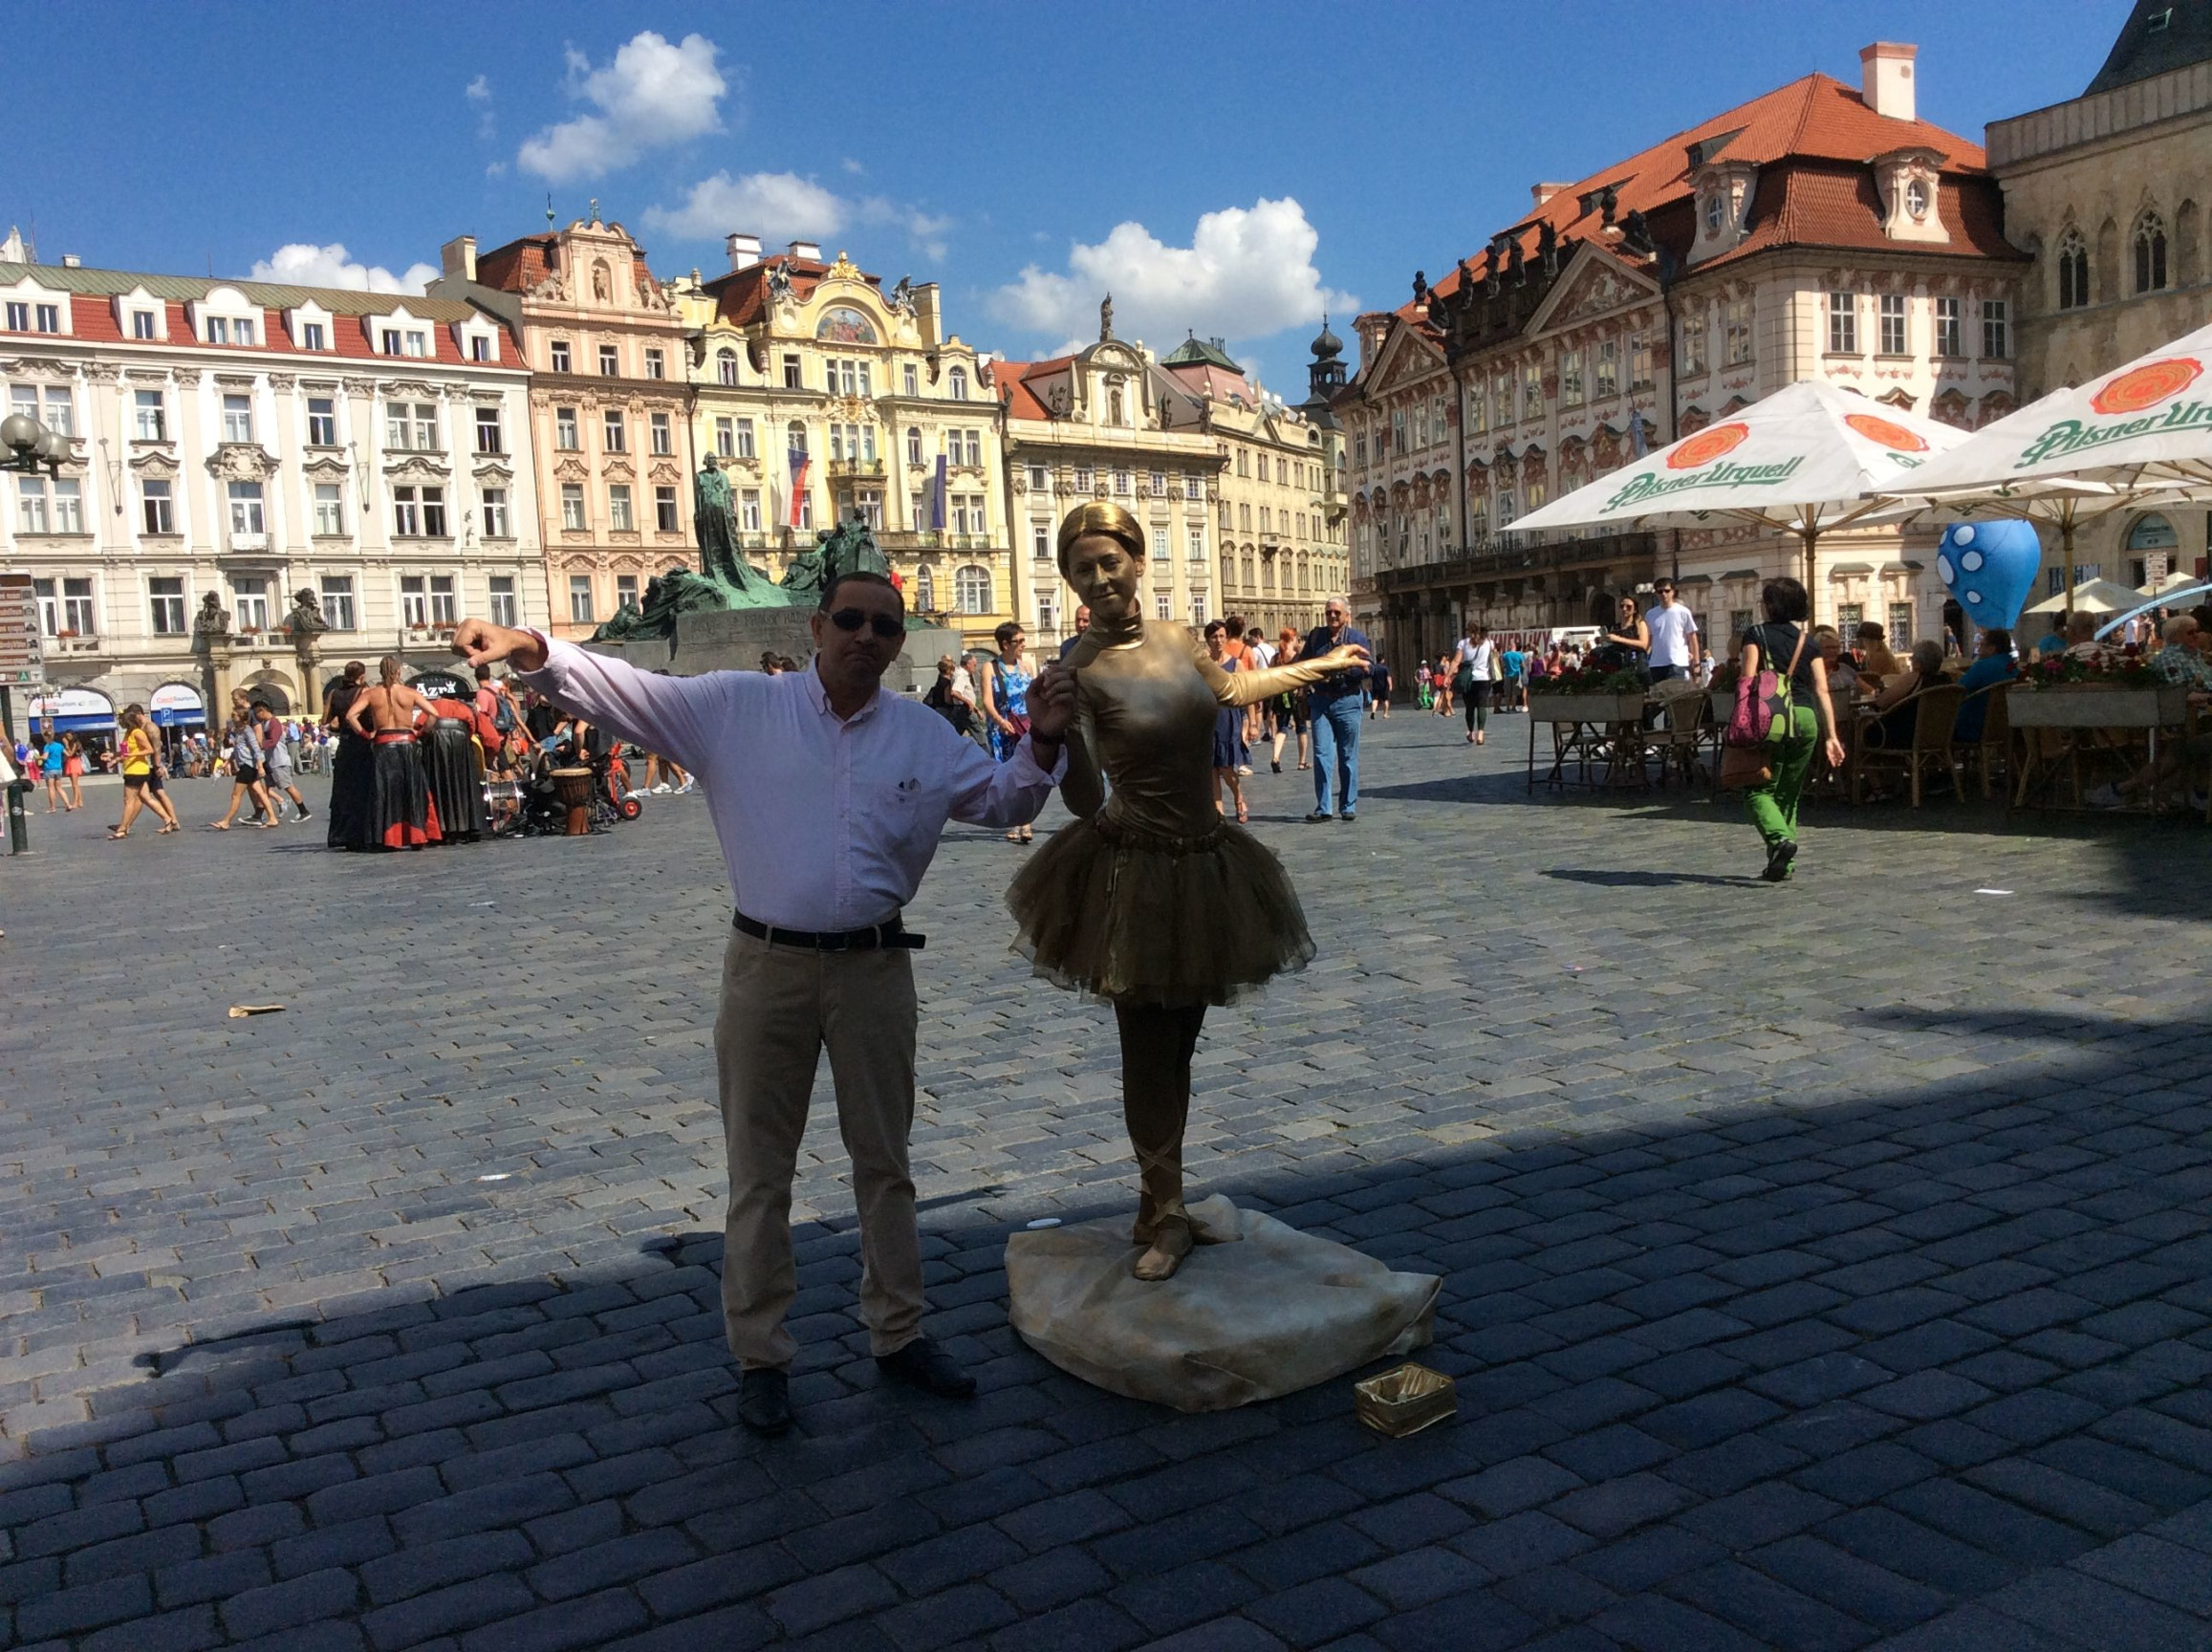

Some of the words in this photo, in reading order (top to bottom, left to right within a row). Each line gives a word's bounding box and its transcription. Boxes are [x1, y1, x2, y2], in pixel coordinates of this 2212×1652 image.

[2014, 412, 2167, 468] Pilsner
[1598, 472, 1712, 514] Pilsner
[1704, 456, 1806, 489] Urquell
[163, 708, 171, 718] P
